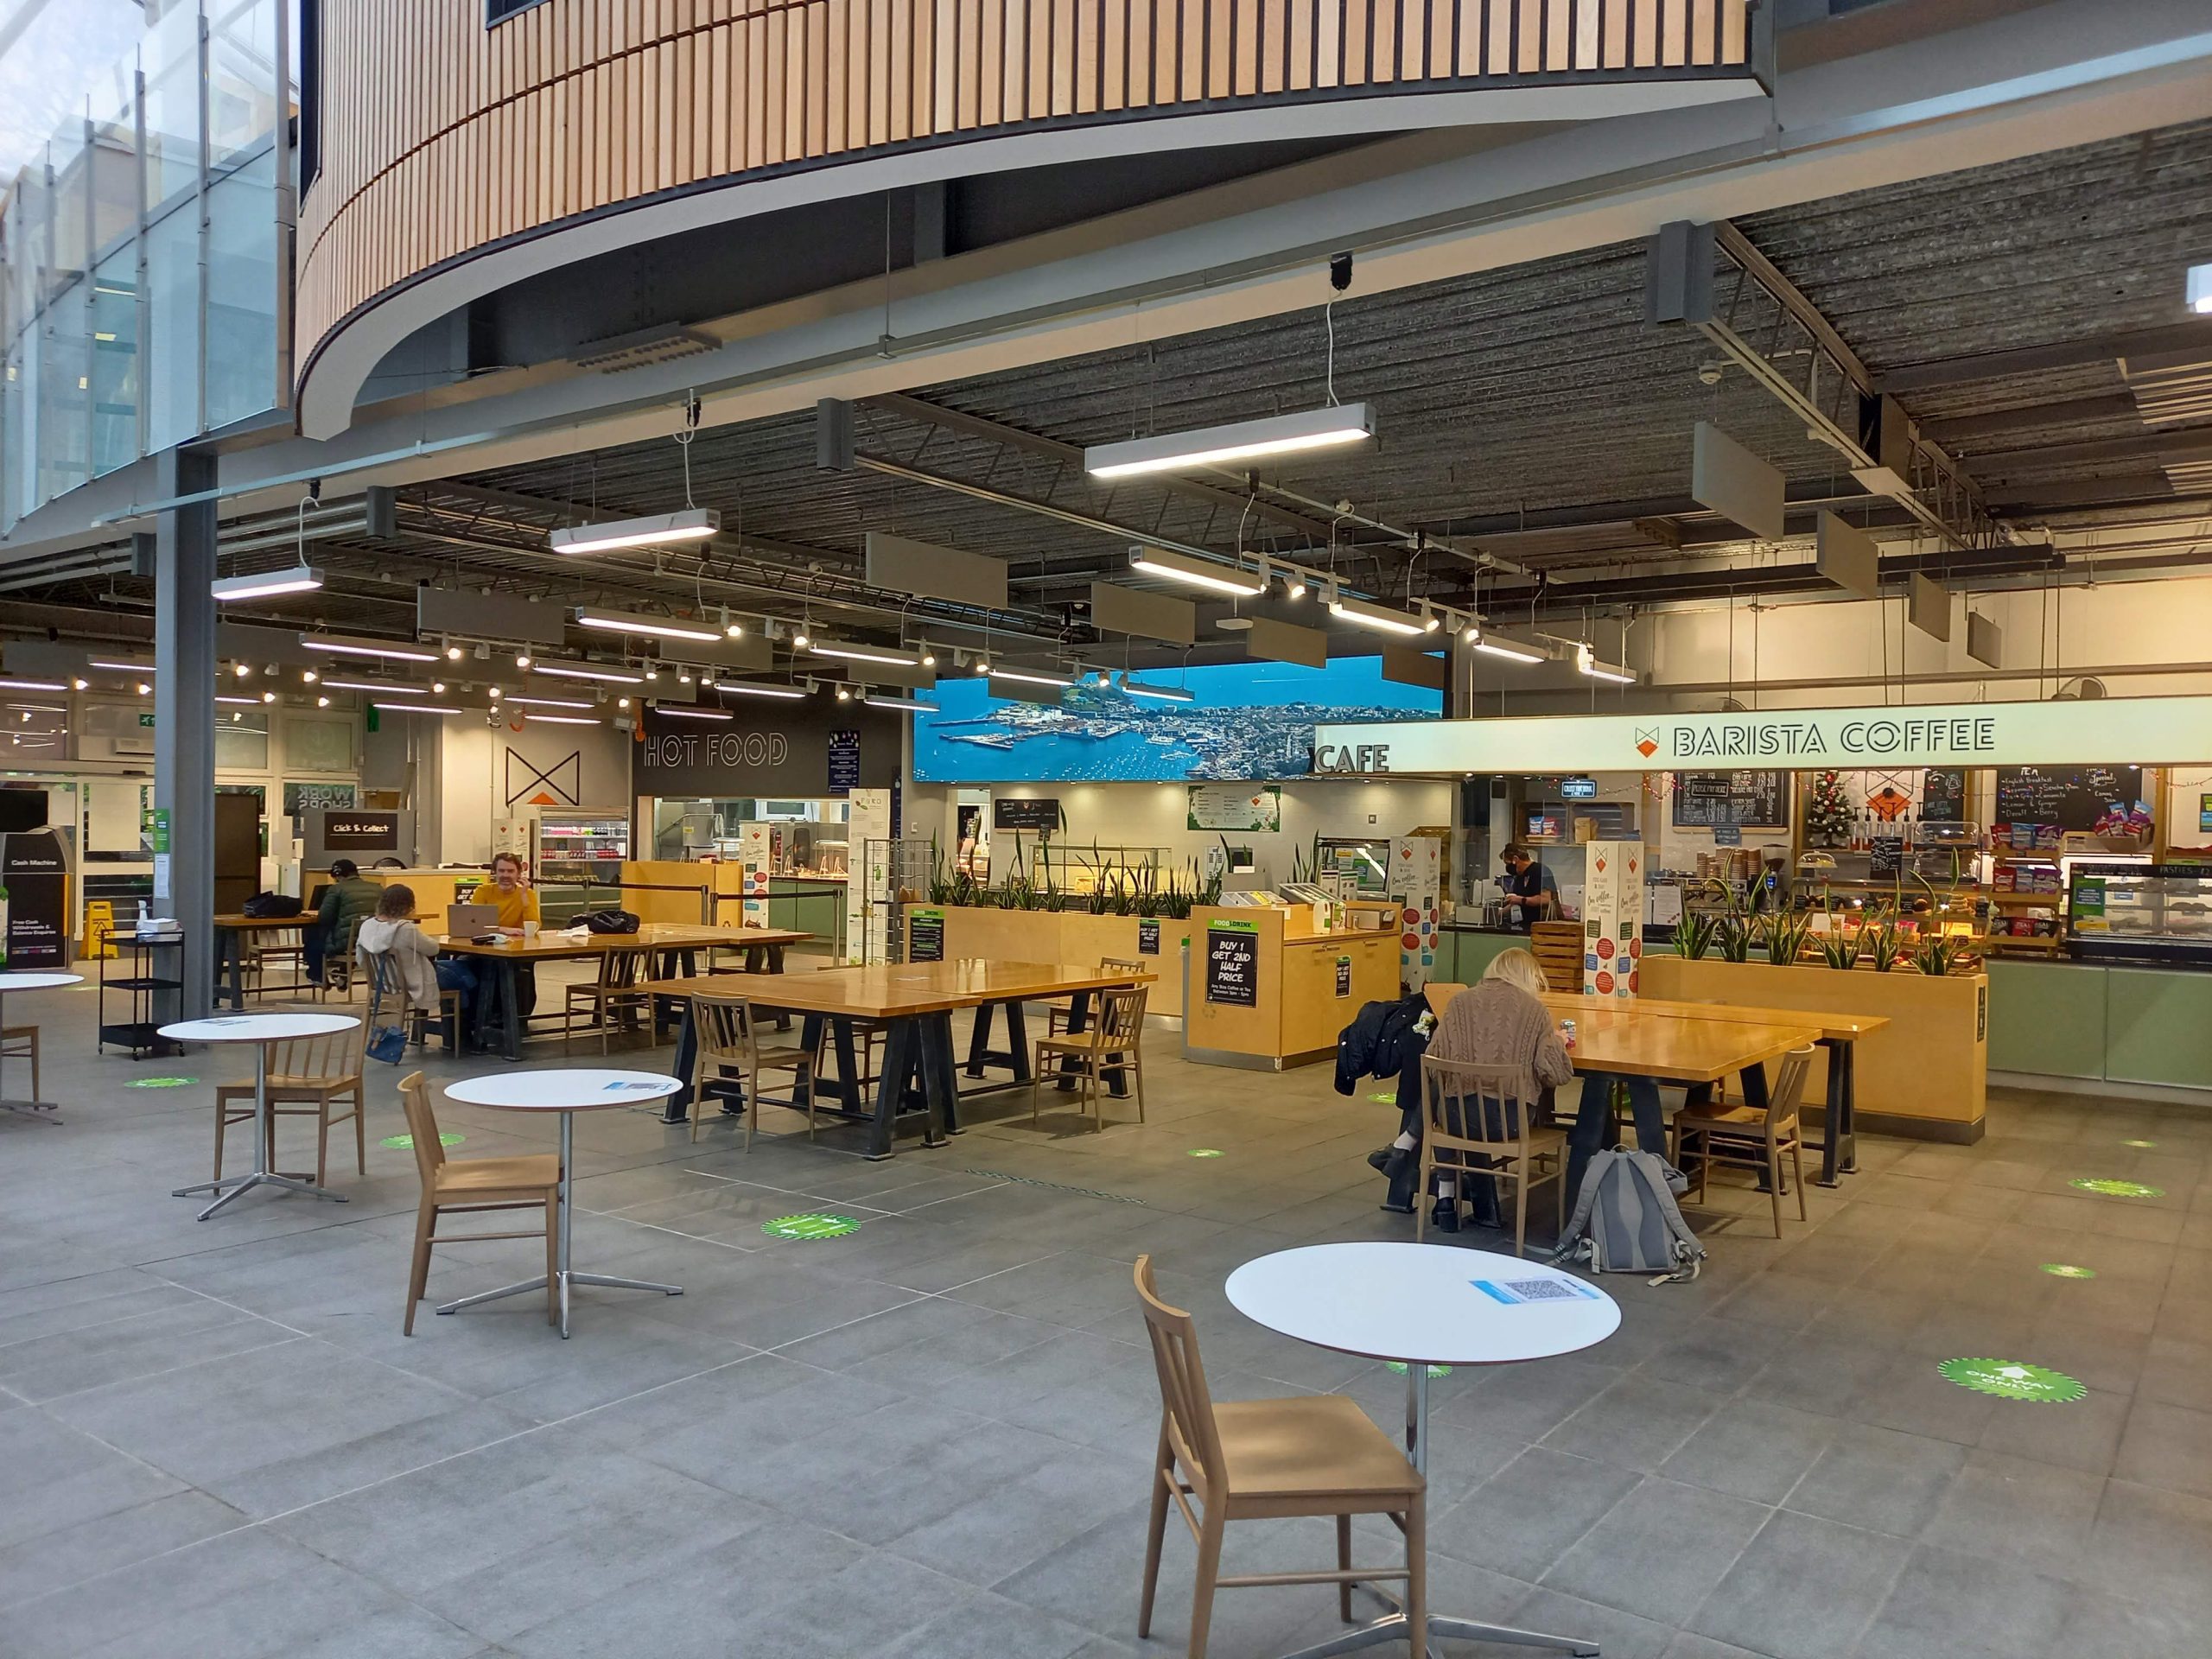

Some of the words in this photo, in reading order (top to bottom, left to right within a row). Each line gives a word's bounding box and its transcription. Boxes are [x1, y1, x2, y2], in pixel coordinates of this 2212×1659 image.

[1673, 723, 1827, 757] BARISTA
[1840, 717, 1995, 753] COFFEE
[644, 734, 698, 767] HOT
[707, 732, 788, 766] FOOD
[1313, 744, 1390, 773] CAFE
[2020, 767, 2039, 776] TEA
[2038, 809, 2059, 819] Berry
[1219, 941, 1238, 950] BUY
[1240, 943, 1245, 951] 1
[1211, 951, 1232, 961] GET
[1233, 953, 1251, 962] 2ND
[1220, 961, 1243, 972] HALF
[1217, 972, 1244, 982] PRICE
[1966, 1370, 2005, 1382] ONE
[2011, 1378, 2056, 1390] WAY
[1981, 1377, 2033, 1391] ONLY
